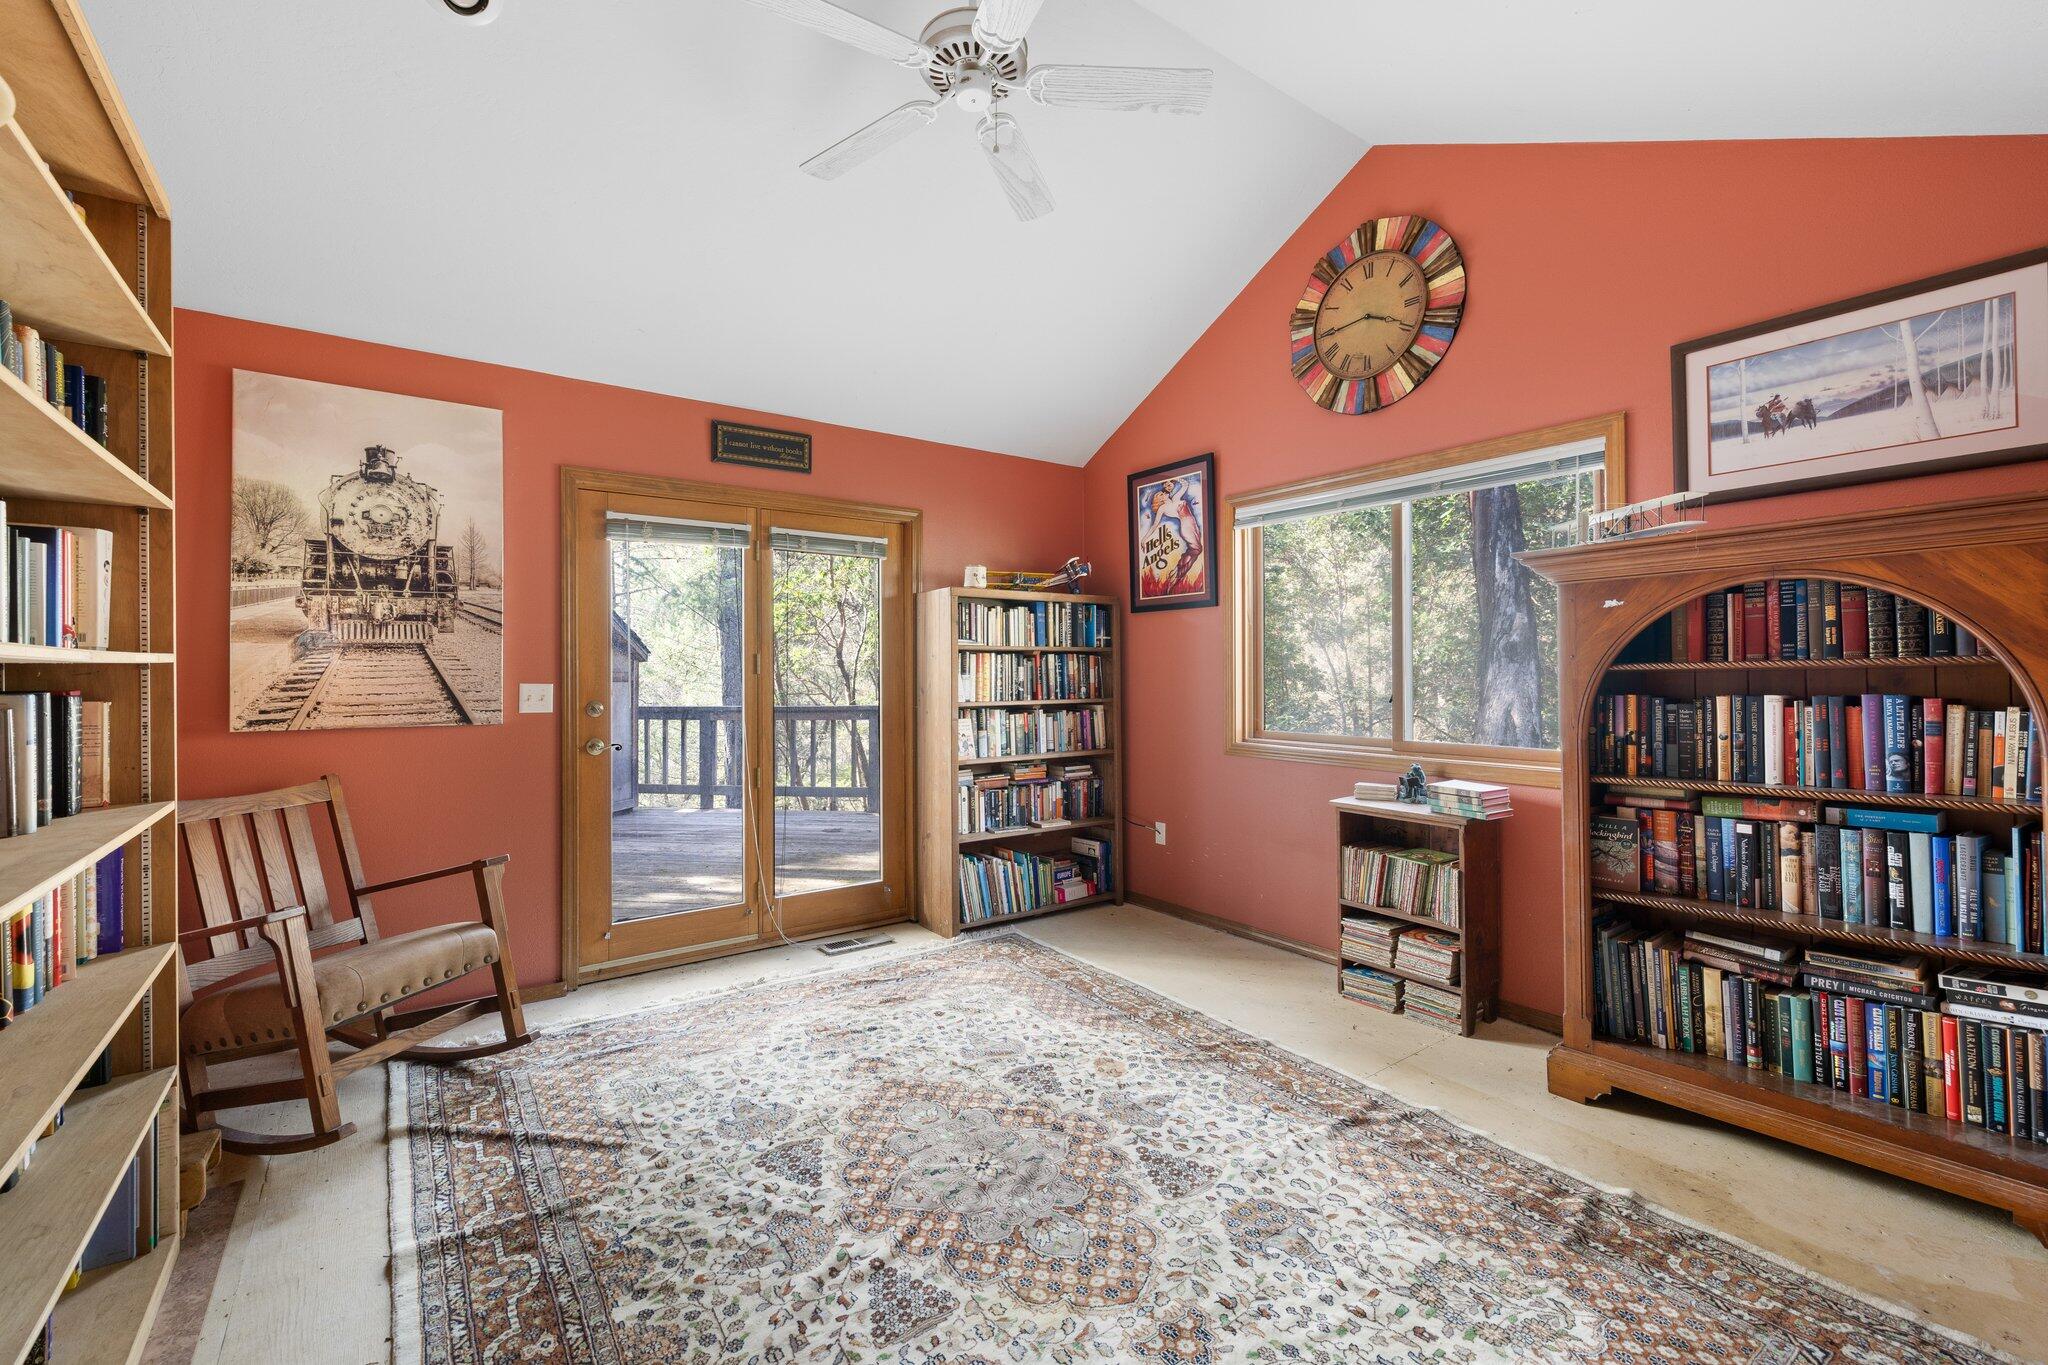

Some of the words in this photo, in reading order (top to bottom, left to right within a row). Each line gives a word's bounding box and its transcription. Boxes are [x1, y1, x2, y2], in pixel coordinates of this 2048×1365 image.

[729, 440, 749, 448] cannot
[750, 441, 761, 450] live
[762, 444, 784, 452] without
[785, 446, 803, 455] books
[1142, 539, 1180, 570] Angels
[1655, 706, 1663, 719] CLIVE
[1895, 706, 1905, 731] LITTLE
[1655, 720, 1663, 741] CUSSLER
[1896, 732, 1906, 749] LIFE
[1590, 829, 1634, 841] ockingbird
[1711, 841, 1719, 855] Trojan
[1887, 845, 1895, 866] CUSSLER
[1711, 855, 1719, 873] Odyssey
[1894, 852, 1903, 867] CLIVE
[1740, 863, 1749, 891] Butterflies
[1818, 867, 1826, 893] STRAUB
[1896, 883, 1905, 908] VALHALLA
[1969, 889, 1977, 901] FALL
[1960, 894, 1968, 924] WILMSLOW
[1970, 912, 1978, 924] MAN
[1821, 957, 1850, 966] GOLEM
[1680, 974, 1689, 1016] KABBALAH
[1810, 976, 1840, 991] PREY
[1849, 986, 1877, 997] MICHAEL
[1879, 991, 1913, 1003] CRICHTON
[1834, 999, 1845, 1017] CLIVE
[1873, 1008, 1883, 1025] CLIVE
[1889, 1010, 1897, 1020] THE
[1962, 1009, 1998, 1019] GRISHAM
[1682, 1016, 1690, 1039] BOOK
[1822, 1017, 1828, 1026] TO
[1836, 1017, 1847, 1042] CUSSLER
[1928, 1016, 1937, 1030] JOHN
[1874, 1026, 1884, 1052] CUSSLER
[1890, 1021, 1898, 1050] ASSOCIATE
[1907, 1021, 1917, 1049] BROKER
[1928, 1031, 1937, 1057] GRISHAM
[1991, 1028, 2001, 1044] CLIVE
[1966, 1024, 1977, 1070] MARATHON
[1992, 1044, 2002, 1069] CUSSLER
[2034, 1038, 2043, 1064] Portrait
[1834, 1056, 1843, 1068] LOST
[1889, 1053, 1898, 1068] JOHN
[1908, 1060, 1916, 1079] JOHN
[2015, 1050, 2024, 1073] APPEAL
[1835, 1068, 1845, 1080] CITY
[1891, 1069, 1900, 1094] GRISHAM
[2034, 1071, 2044, 1091] Sepia
[1910, 1079, 1919, 1110] GRISHAM
[1992, 1075, 2003, 1101] SHOCK
[2016, 1076, 2025, 1094] JOHN
[1994, 1101, 2005, 1122] WAVE
[2017, 1094, 2026, 1124] GRISHAM
